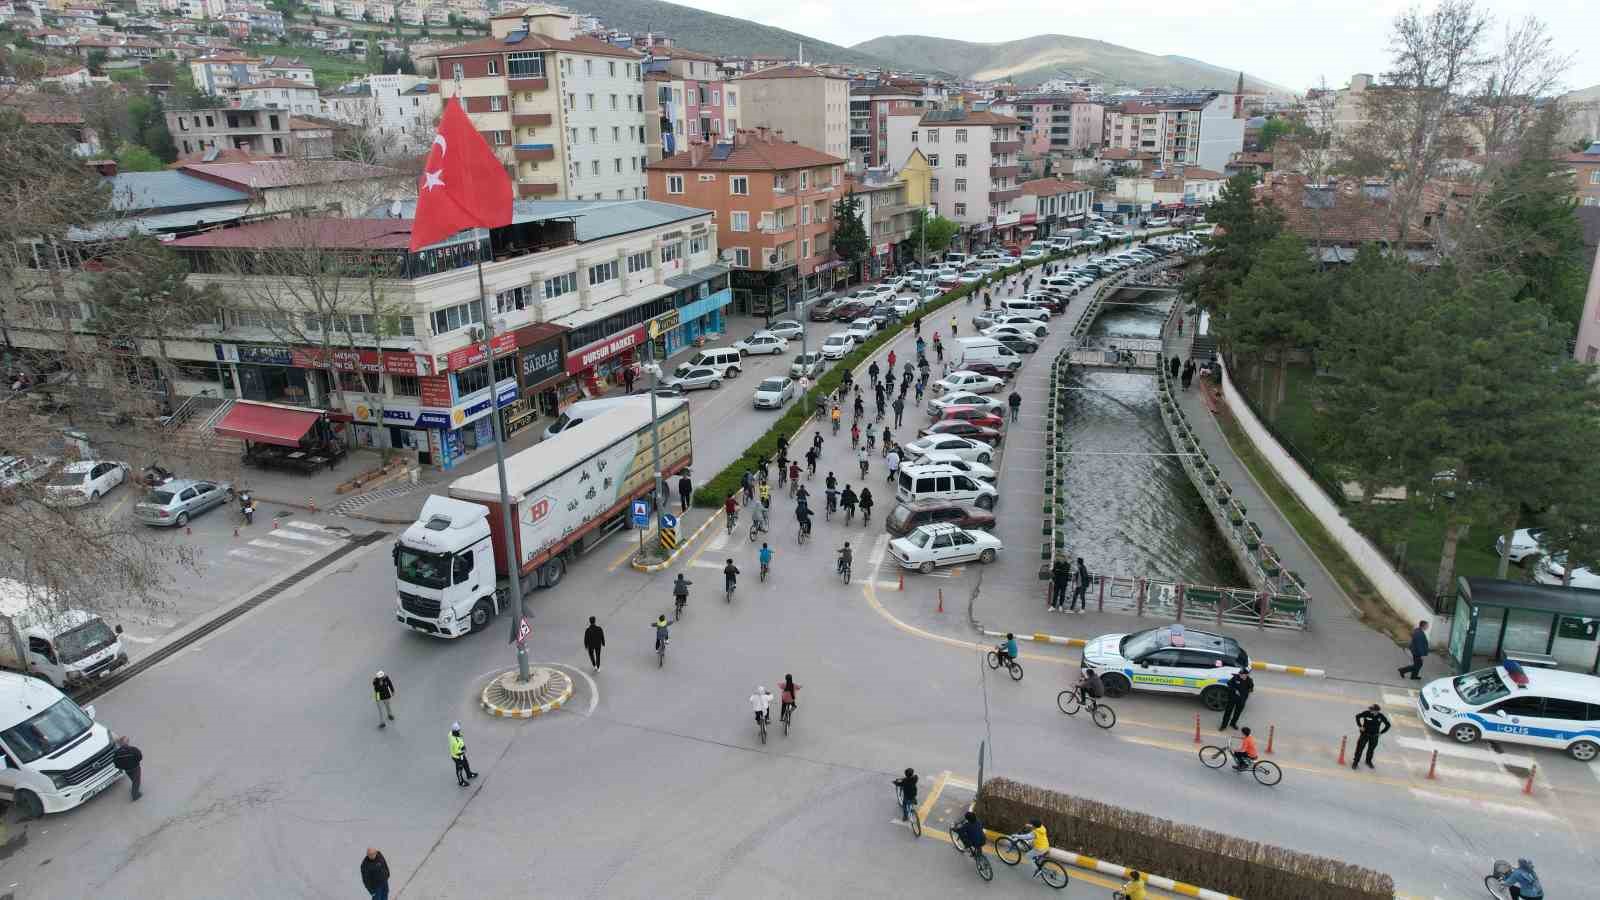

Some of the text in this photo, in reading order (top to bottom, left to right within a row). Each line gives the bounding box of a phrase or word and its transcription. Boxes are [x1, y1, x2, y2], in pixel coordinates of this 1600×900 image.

[523, 350, 560, 376] SARRAF
[583, 334, 636, 366] DURSUN MARKET
